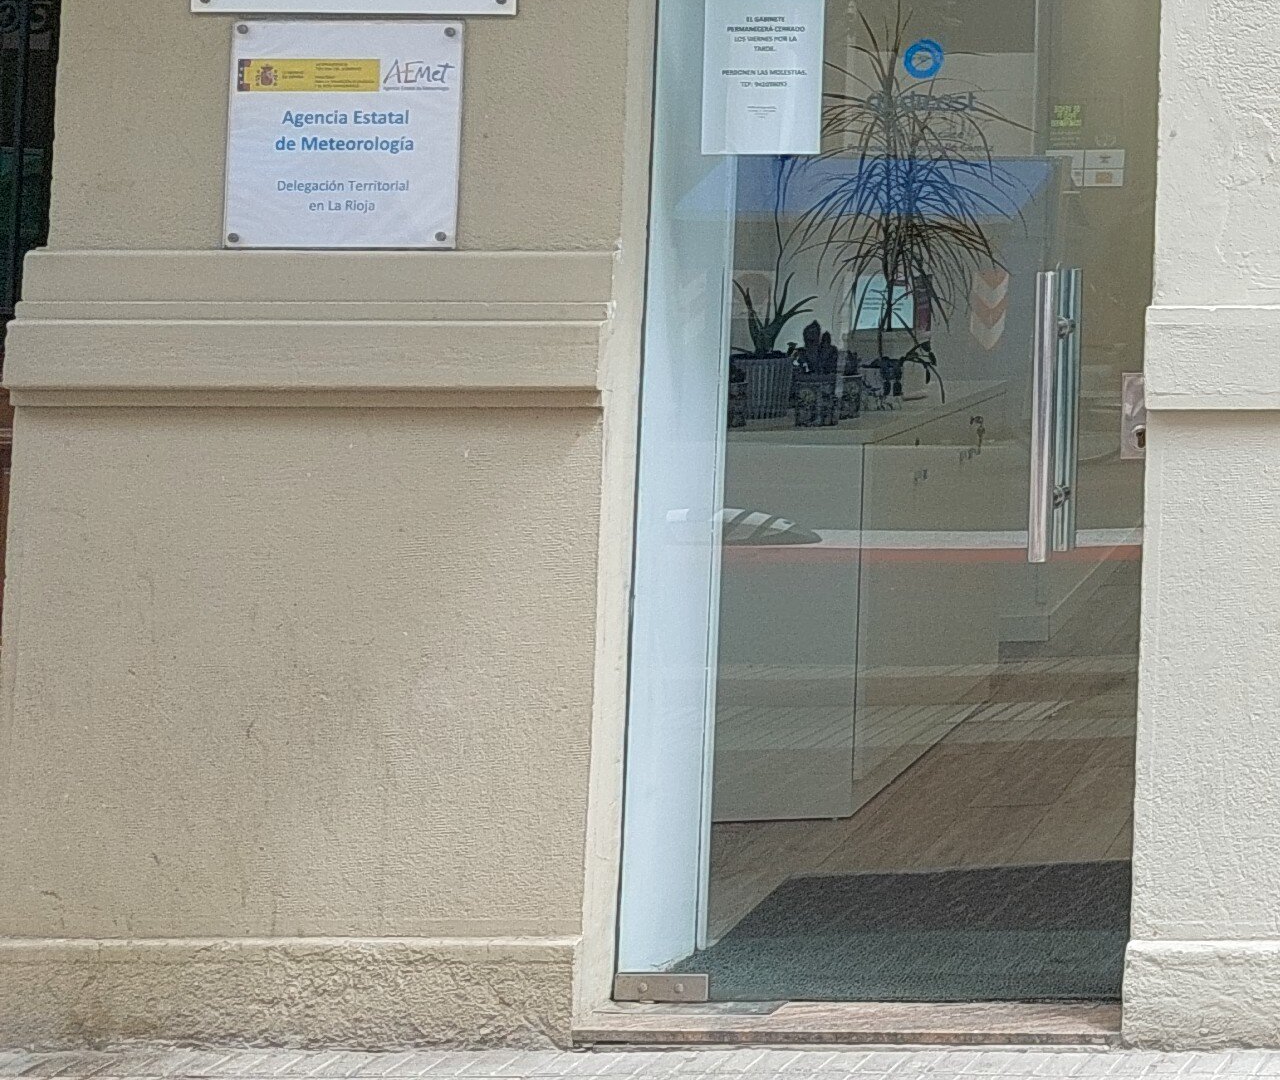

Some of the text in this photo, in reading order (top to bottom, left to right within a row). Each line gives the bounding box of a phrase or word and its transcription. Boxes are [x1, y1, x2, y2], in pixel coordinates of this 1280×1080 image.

[281, 109, 410, 128] Agencia Estatal
[275, 135, 414, 155] de Meteorología
[276, 179, 410, 194] Delegación Territorial
[308, 200, 376, 214] en La Rioja
